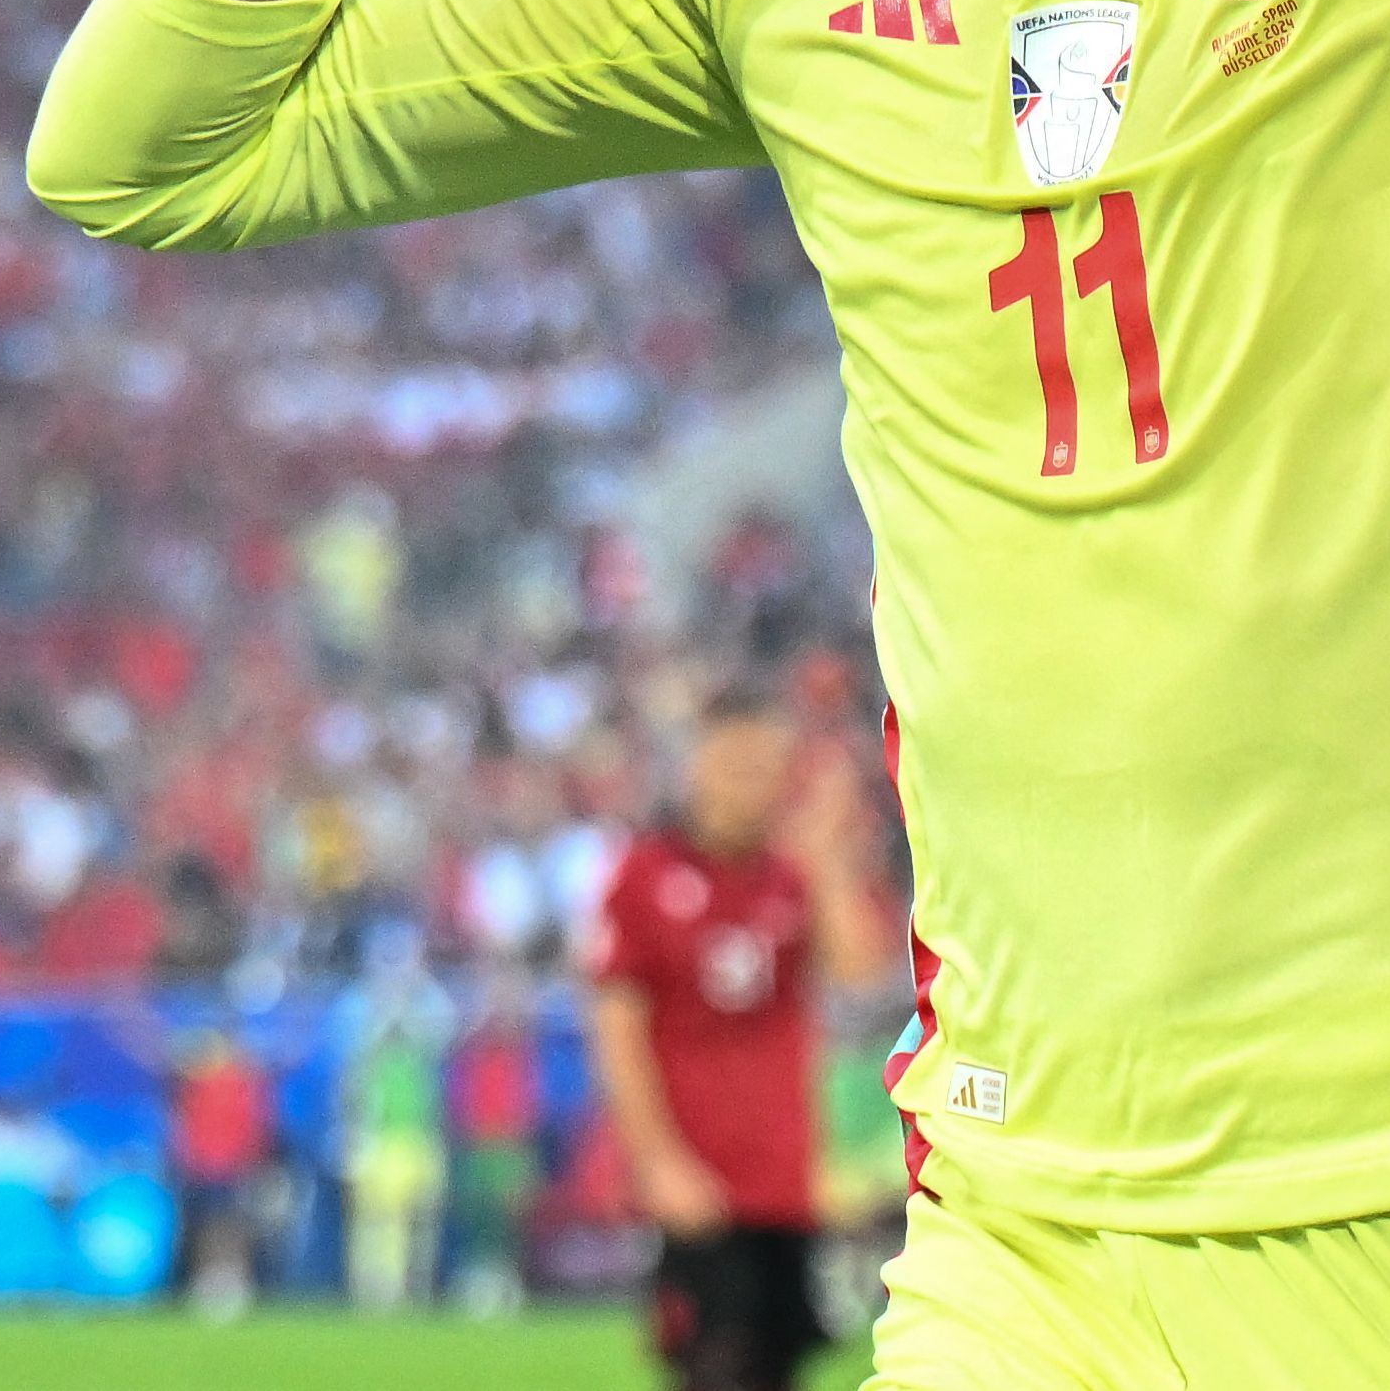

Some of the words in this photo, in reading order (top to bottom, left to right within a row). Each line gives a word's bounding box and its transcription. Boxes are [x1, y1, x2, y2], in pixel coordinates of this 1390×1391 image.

[1016, 16, 1046, 31] UEFA
[1048, 9, 1095, 23] NATIONS
[1097, 8, 1132, 20] LEAGUE
[1262, 0, 1298, 24] SPAIN
[1233, 32, 1262, 56] JUNE
[1263, 18, 1295, 40] 2024
[989, 191, 1169, 477] 11
